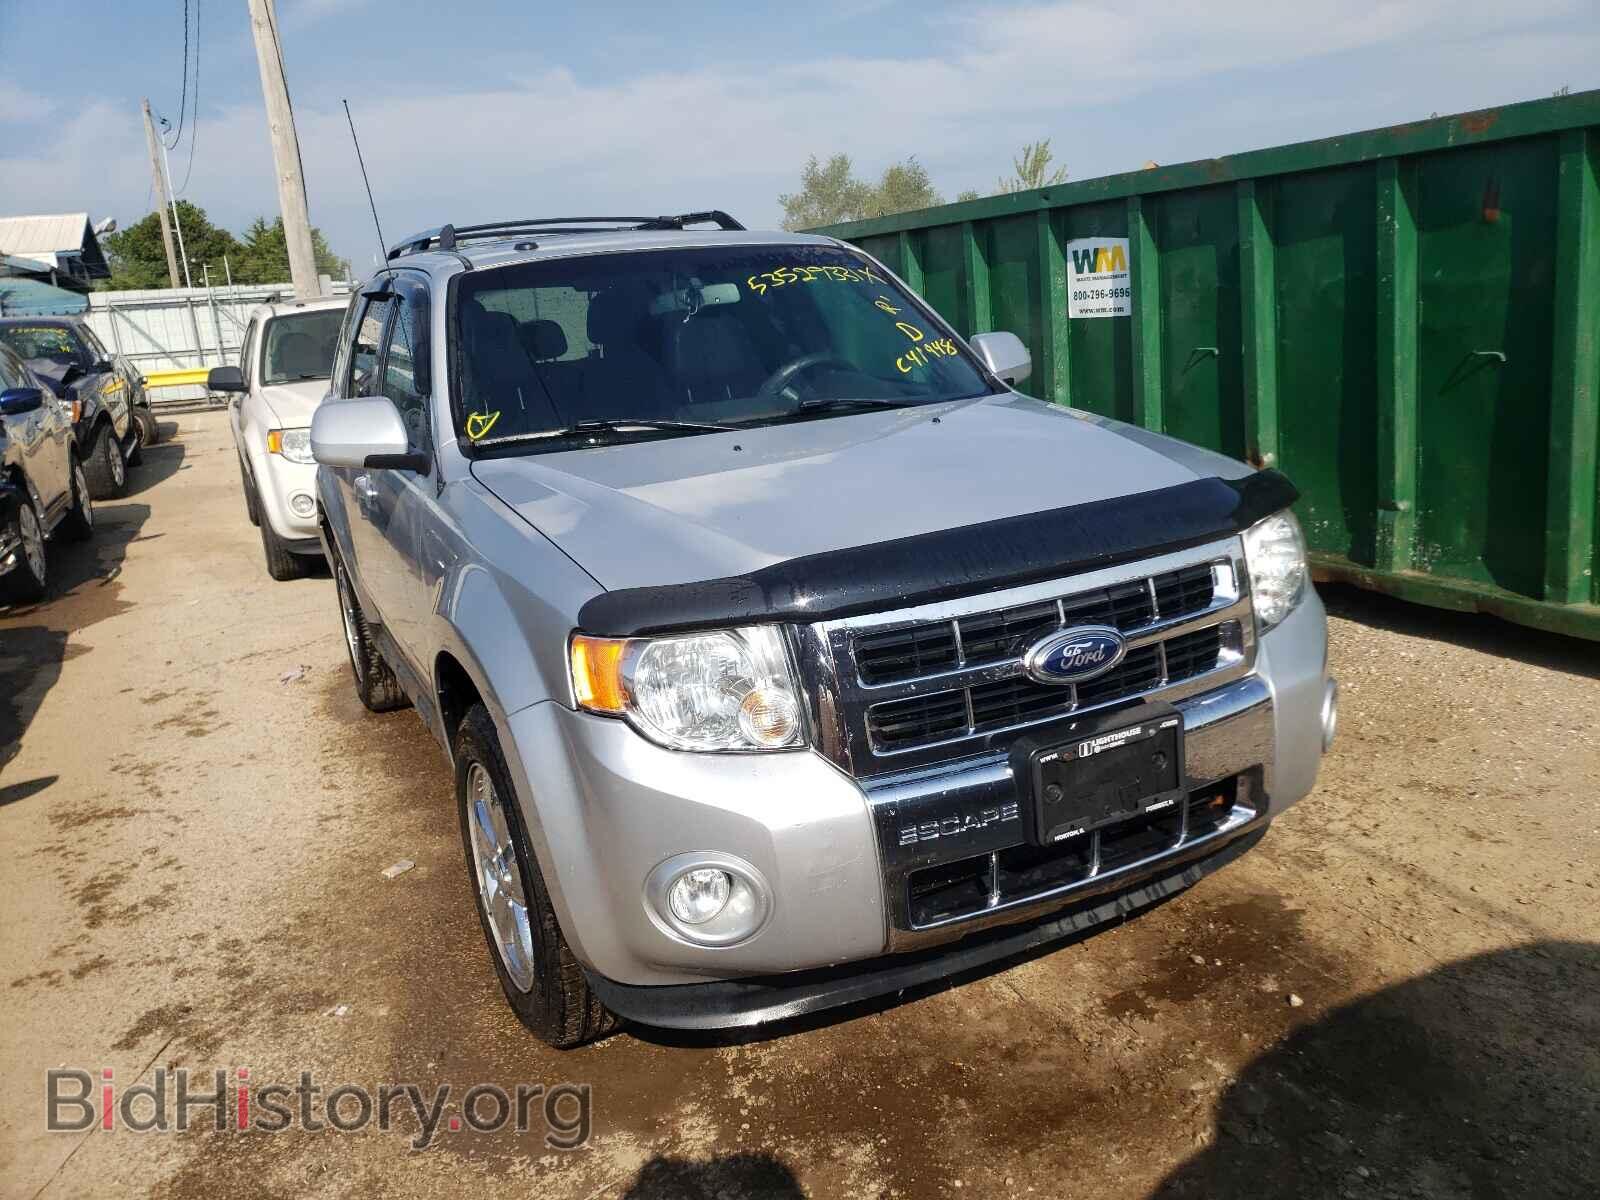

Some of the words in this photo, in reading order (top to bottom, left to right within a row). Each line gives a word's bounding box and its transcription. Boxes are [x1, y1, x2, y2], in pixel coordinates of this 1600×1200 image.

[1072, 245, 1127, 274] WM
[1061, 641, 1105, 670] Ford
[899, 801, 1018, 846] ESCAPE
